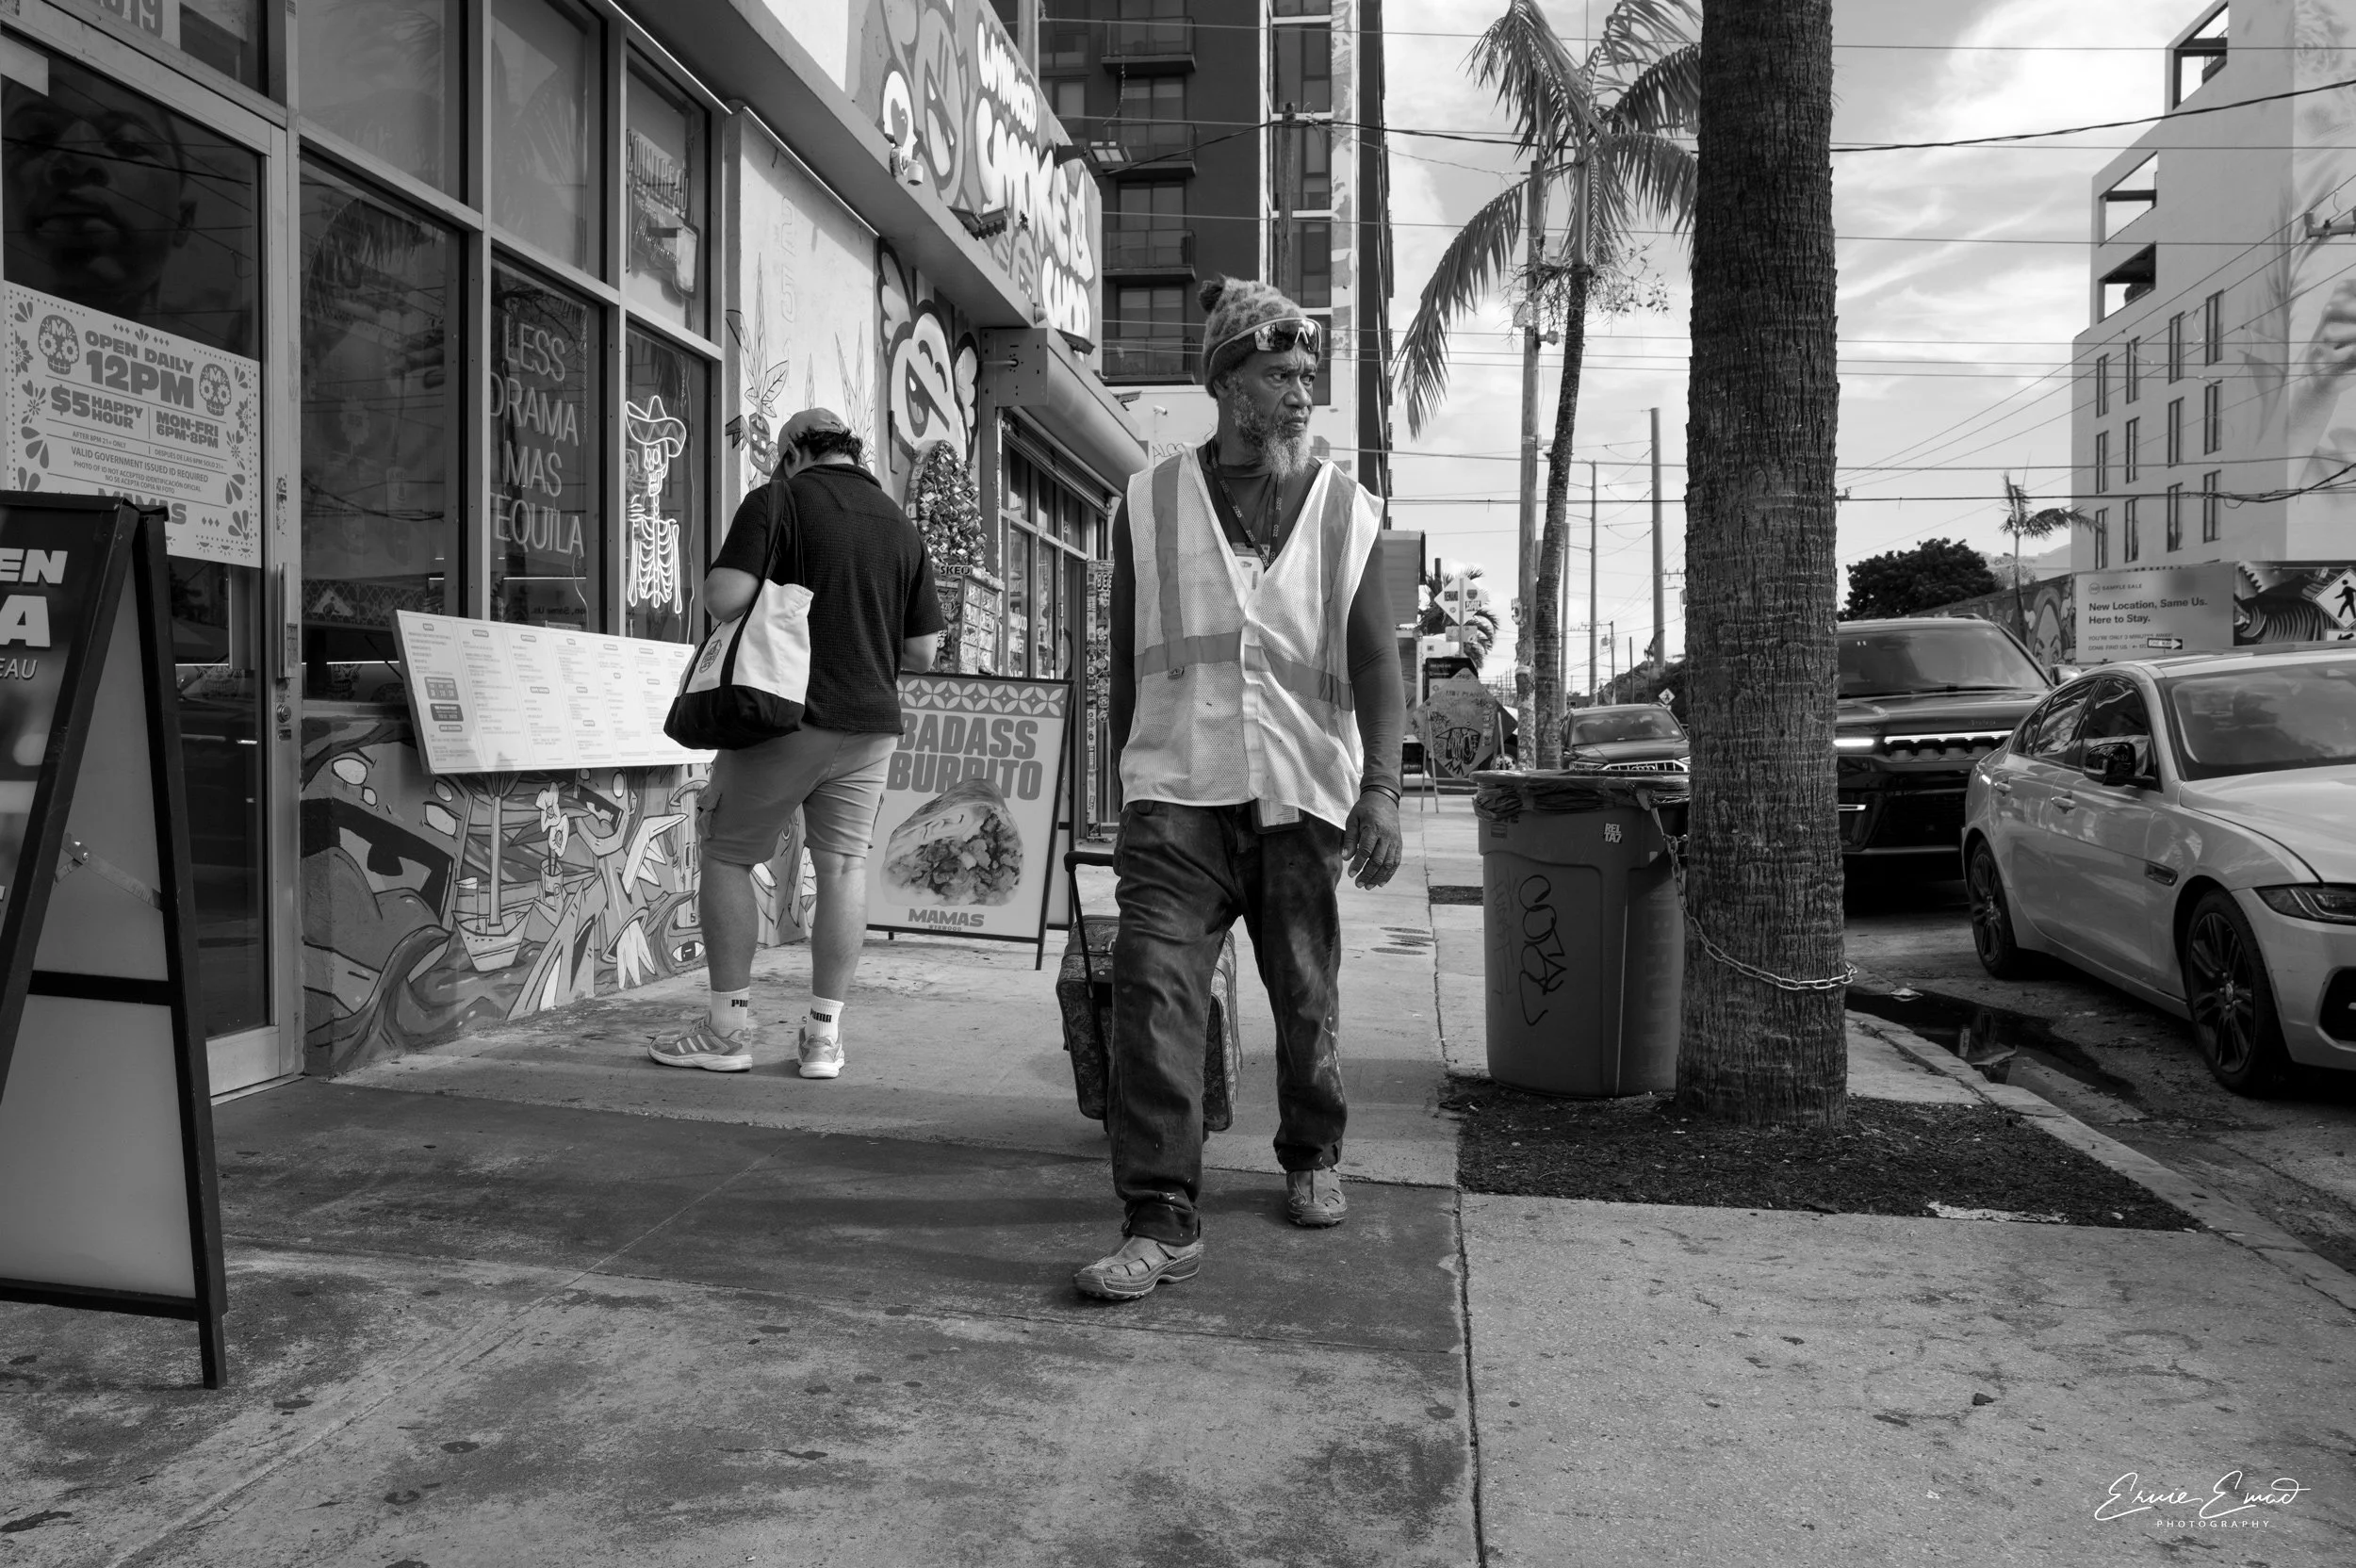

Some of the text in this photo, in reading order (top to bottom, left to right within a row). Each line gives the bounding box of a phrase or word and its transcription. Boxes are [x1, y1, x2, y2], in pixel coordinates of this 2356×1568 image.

[977, 22, 1037, 134] WYNWOOD
[975, 97, 1069, 268] SMOKE
[1042, 256, 1091, 339] SHOP
[85, 330, 194, 374] OPEN DAILY
[503, 316, 565, 382] LESS
[86, 349, 194, 409] 12PM
[50, 384, 90, 417] $5
[91, 395, 143, 419] HAPPY
[490, 371, 580, 447] DRAMA
[91, 410, 134, 430] HOUR
[155, 410, 219, 437] MON-FRI
[156, 425, 219, 449] 6PM-8PM
[73, 431, 90, 441] AFTER
[90, 434, 101, 444] 8PM
[112, 440, 126, 449] ONLY
[71, 446, 209, 482] VALID GOVERNMENT ISSUED ID REQUIRED
[74, 460, 93, 470] PHOTO
[108, 466, 119, 476] NOT
[120, 469, 144, 482] ACCEPTED
[504, 440, 562, 498] MAS
[2088, 596, 2208, 612] New Location, Same Us.
[2088, 613, 2151, 625] Here to Stay.
[896, 712, 1039, 760] BADASS
[908, 908, 985, 927] MAMAS
